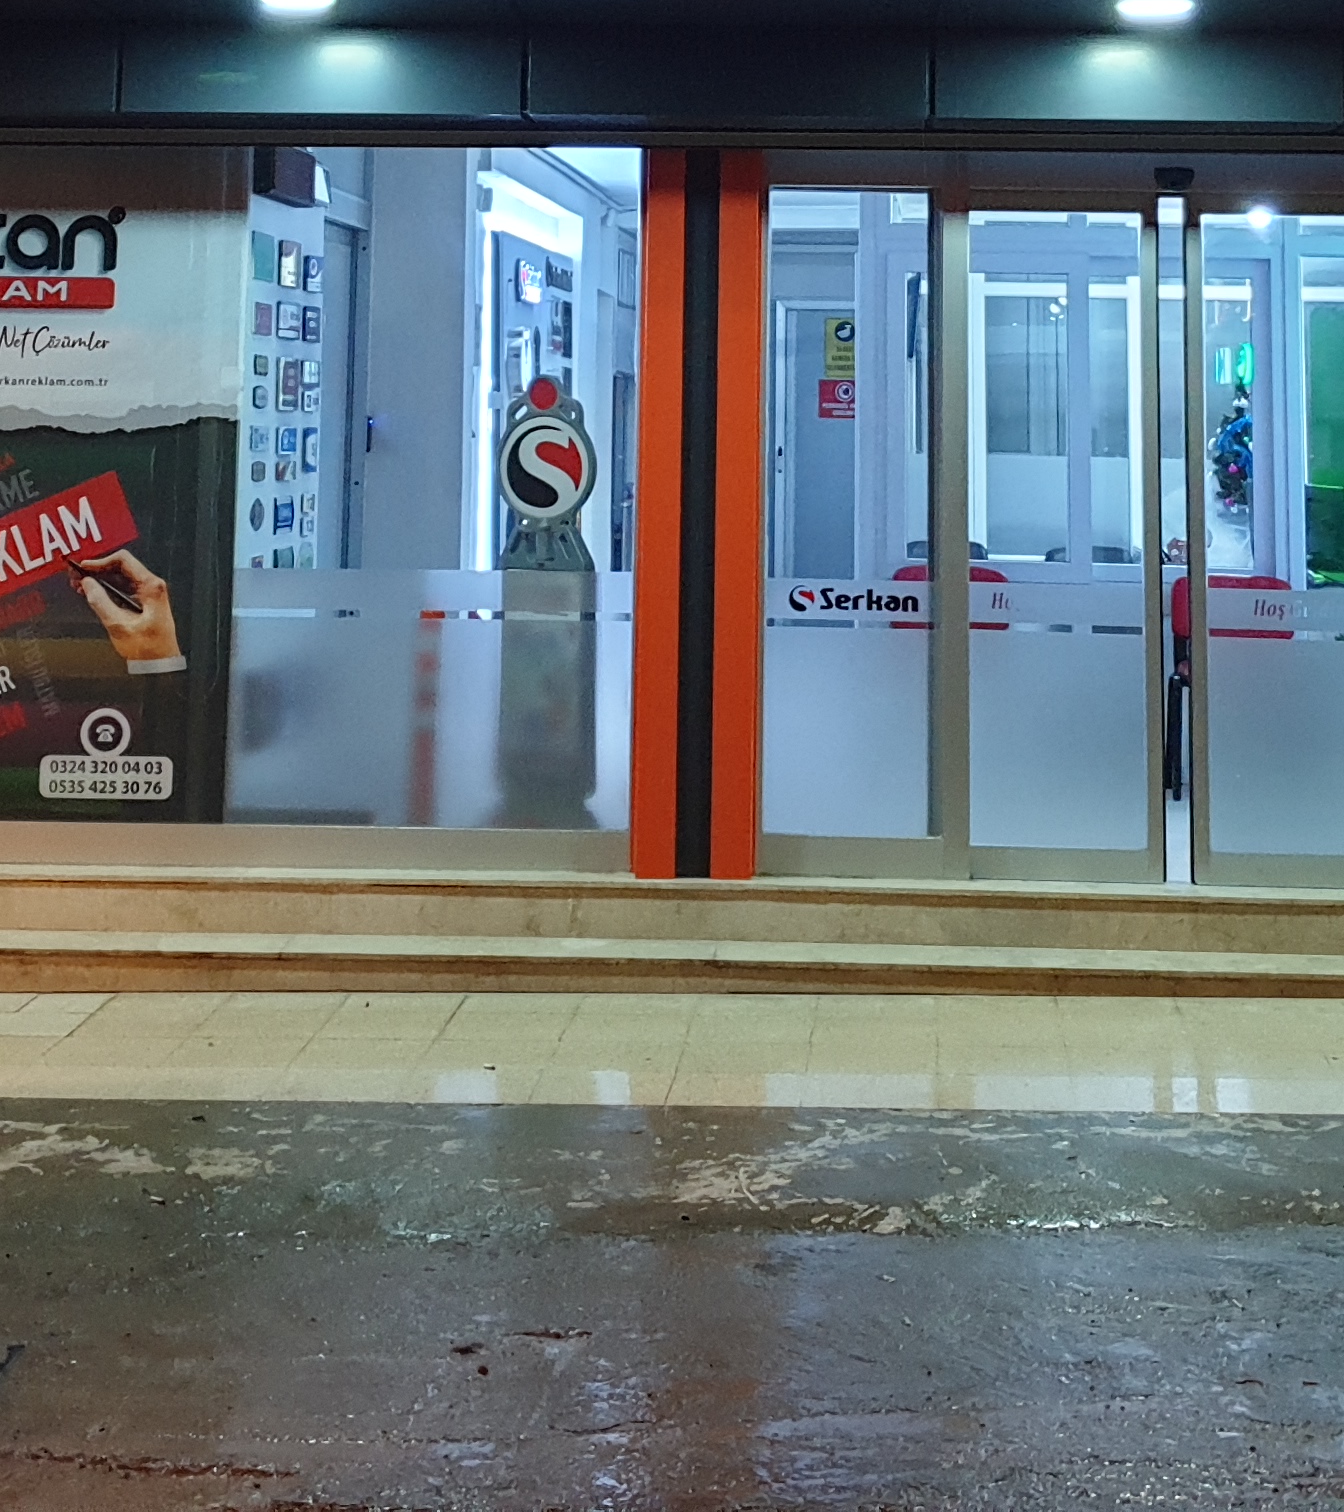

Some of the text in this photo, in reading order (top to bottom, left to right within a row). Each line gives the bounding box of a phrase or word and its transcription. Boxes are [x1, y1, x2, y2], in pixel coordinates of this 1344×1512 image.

[32, 324, 110, 357] Çözümler
[818, 587, 920, 613] Serkan
[49, 759, 163, 775] 0324 320 04 03
[48, 779, 163, 795] 0535 425 30 76
